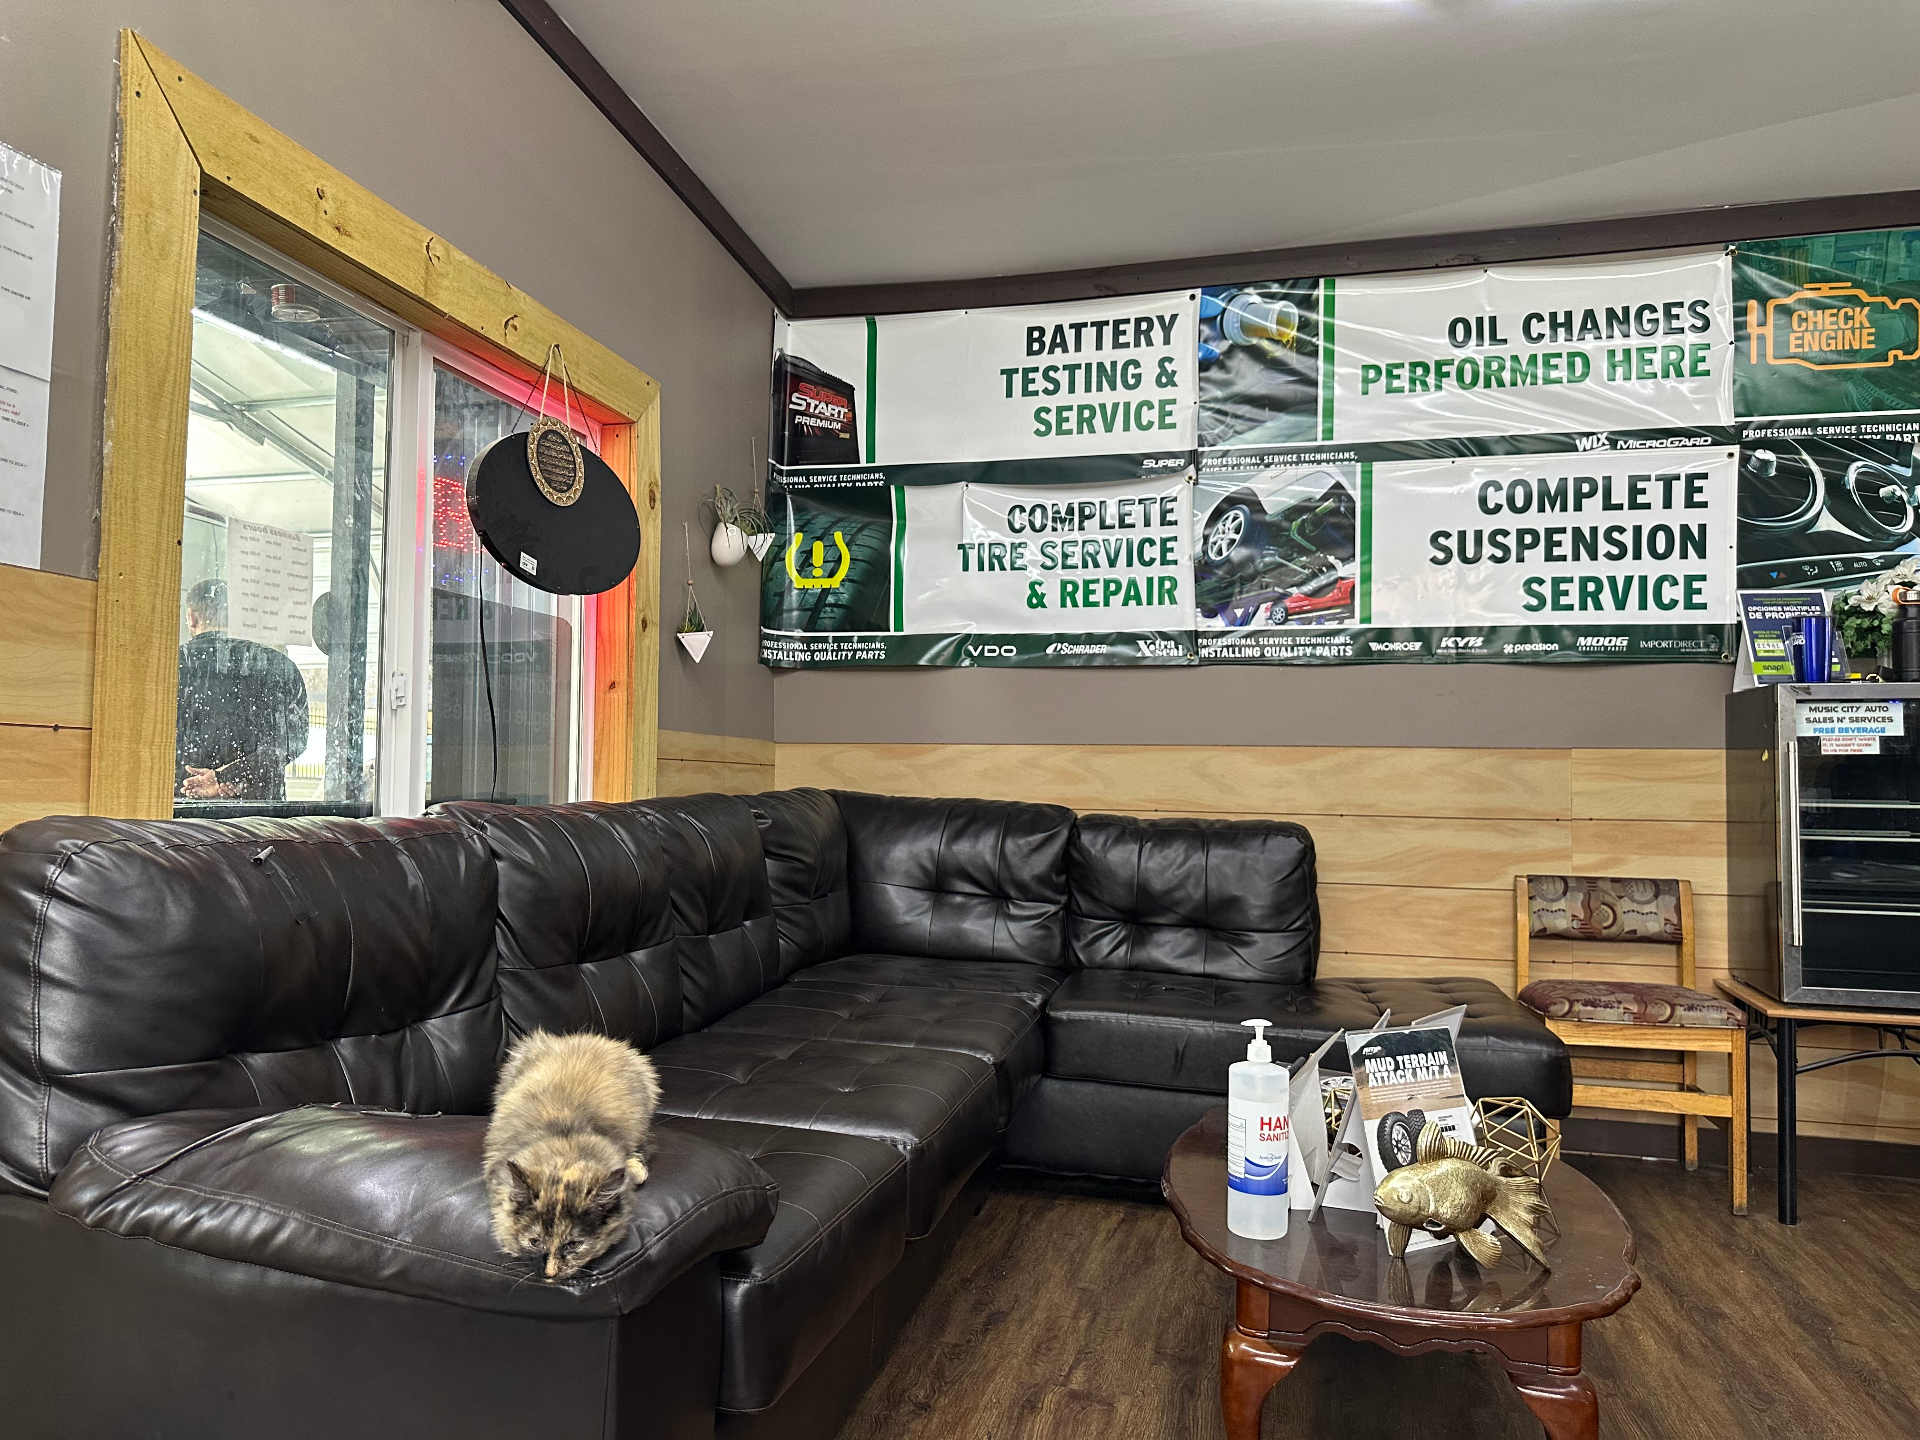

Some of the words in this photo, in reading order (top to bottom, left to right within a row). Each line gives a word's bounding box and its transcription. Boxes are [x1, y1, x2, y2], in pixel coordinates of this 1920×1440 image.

[1448, 313, 1508, 349] OIL
[1522, 298, 1711, 345] CHANGES
[1791, 306, 1871, 332] CHECK
[1025, 313, 1179, 357] BATTERY
[1789, 328, 1876, 353] ENGINE
[1000, 358, 1143, 399] TESTING
[1155, 356, 1179, 389] &
[1360, 350, 1591, 397] PERFORMED
[1606, 342, 1712, 384] HERE
[789, 392, 849, 419] START
[798, 382, 848, 408] SUPER
[795, 415, 842, 430] PREMIUM
[1033, 398, 1178, 438] SERVICE
[1576, 431, 1611, 452] WIX
[1742, 427, 1814, 439] PROFESSIONAL
[1816, 425, 1857, 435] SERVICE
[1860, 423, 1920, 433] TECHNICIAN
[1141, 458, 1185, 468] SUPER
[1202, 456, 1261, 466] PROFESSIONAL
[1263, 453, 1298, 463] SERVICE
[1300, 451, 1358, 461] TECHNICIANS,
[809, 474, 837, 483] SERVICE
[839, 472, 886, 481] TECHNICIANS,
[1476, 471, 1710, 515] COMPLETE
[1008, 495, 1179, 534] COMPLETE
[957, 541, 1026, 572] TIRE
[1039, 536, 1179, 571] SERVICE
[1428, 522, 1708, 566] SUSPENSION
[1026, 580, 1048, 609] &
[1059, 575, 1179, 609] REPAIR
[1520, 573, 1708, 613] SERVICE
[810, 642, 838, 650] SERVICE
[840, 642, 887, 650] TECHNICIANS,
[968, 645, 1017, 656] VDO
[1198, 637, 1256, 646] PROFESSIONAL
[1258, 636, 1293, 645] SERVICE
[1295, 636, 1354, 645] TECHNICIANS,
[1198, 647, 1260, 658] INSTALLING
[1264, 646, 1312, 657] QUALITY
[1315, 645, 1353, 656] PARTS
[1374, 641, 1417, 651] MONROE
[1440, 636, 1485, 648] KYB
[1514, 643, 1559, 653] precision
[1576, 636, 1629, 646] MOOG
[814, 650, 853, 661] QUALITY
[855, 650, 886, 660] PARTS
[1805, 716, 1835, 724] SALES
[1808, 705, 1839, 713] MUSIC
[1841, 705, 1861, 713] CITY
[1864, 705, 1889, 713] AUTO
[1364, 1056, 1395, 1074] MUD
[1396, 1050, 1449, 1070] TERRAIN
[1368, 1067, 1415, 1088] ATTACK
[1416, 1065, 1440, 1082] M/T
[1442, 1064, 1452, 1078] A
